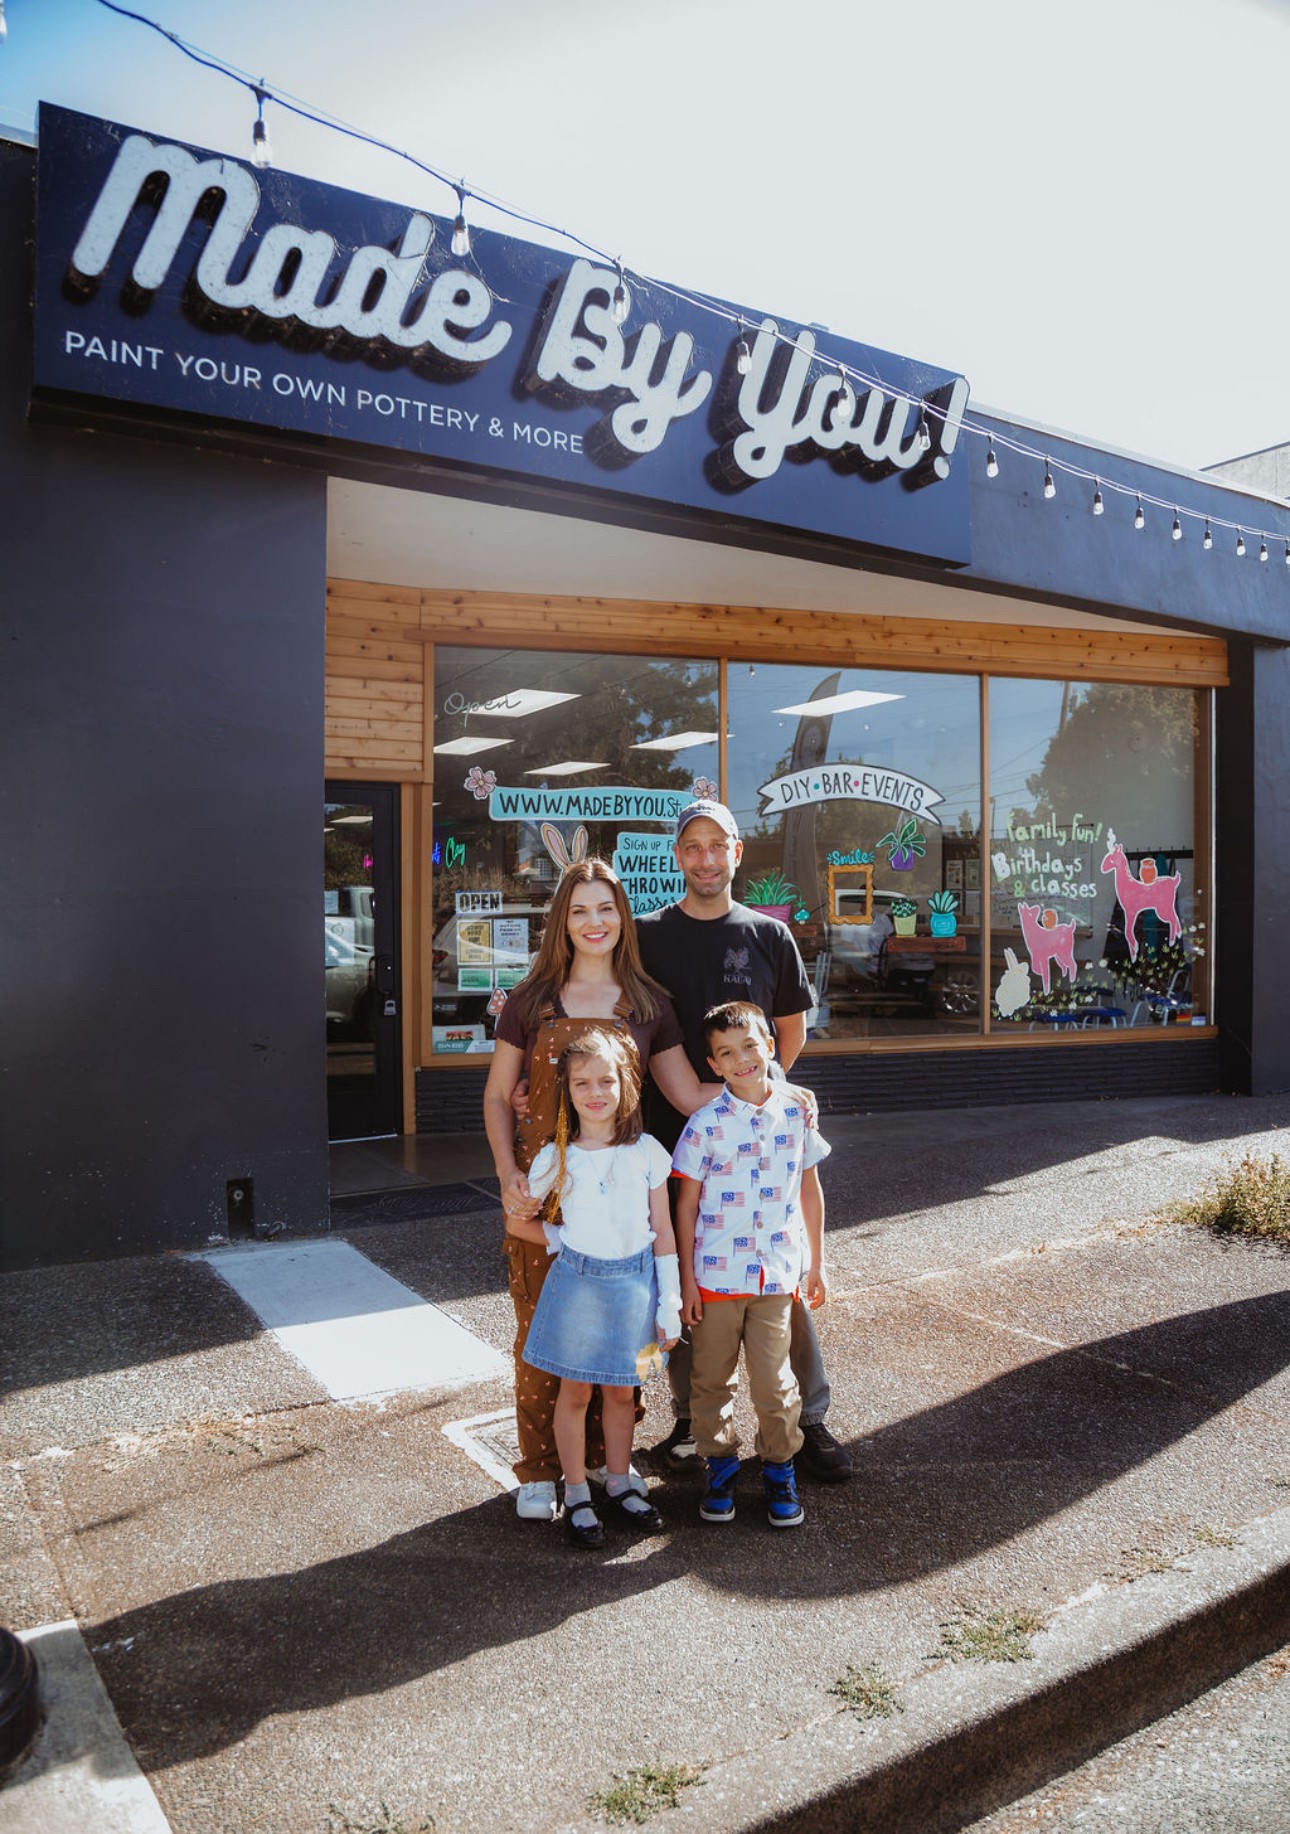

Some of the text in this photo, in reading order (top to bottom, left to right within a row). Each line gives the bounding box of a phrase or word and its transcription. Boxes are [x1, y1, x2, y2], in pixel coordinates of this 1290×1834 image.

[72, 134, 970, 480] Made By You!
[64, 330, 584, 454] PAINT YOUR OWN POTTERY & MORE
[444, 692, 522, 728] Open
[781, 772, 924, 811] DIY BAR EVENTS
[499, 793, 692, 818] WWW.MADEBYYOU.St
[623, 837, 647, 851] SIGN
[831, 848, 870, 865] Smile
[618, 855, 681, 873] WHEEL
[991, 847, 1082, 882] Birthdays
[1014, 874, 1097, 898] & classes
[459, 893, 500, 912] OPEN
